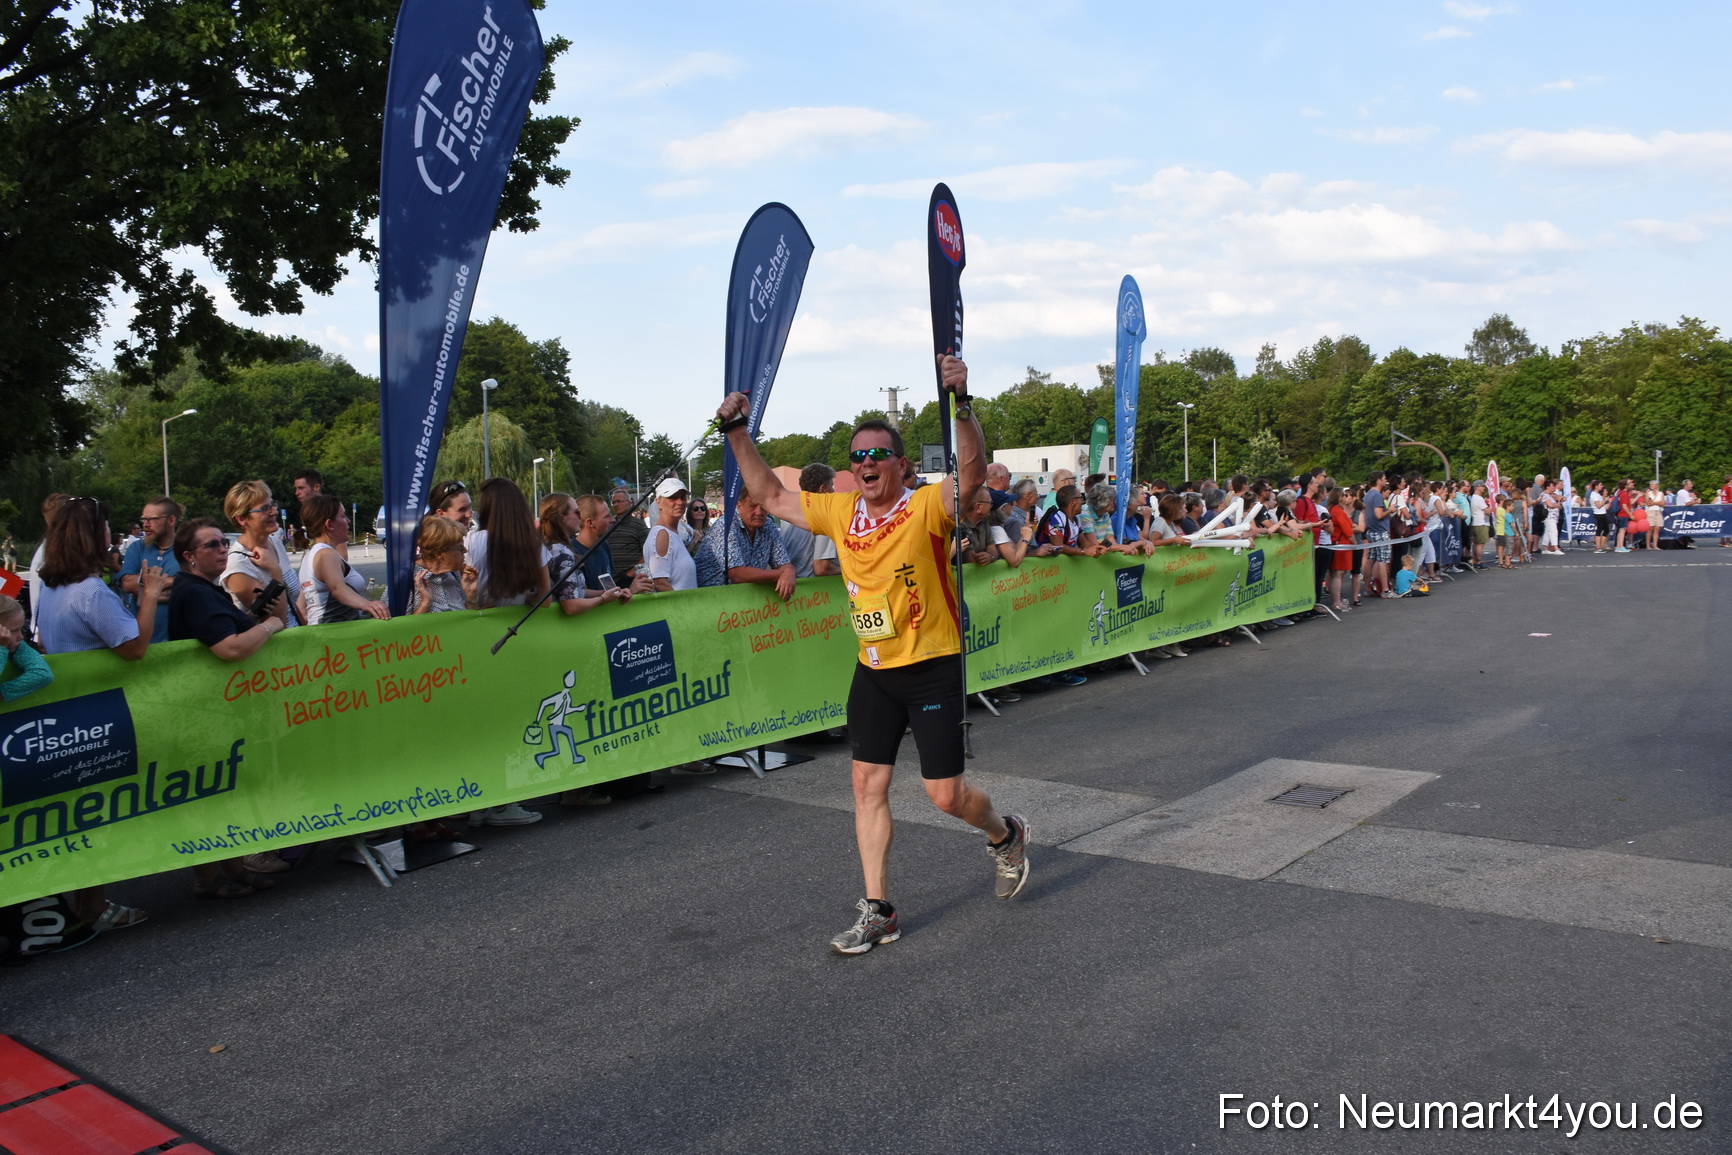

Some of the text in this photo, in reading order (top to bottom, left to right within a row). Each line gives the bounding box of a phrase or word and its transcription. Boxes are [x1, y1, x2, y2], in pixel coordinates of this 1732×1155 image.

[436, 6, 503, 166] Fischer
[468, 35, 515, 162] AUTOMOBILE
[757, 234, 787, 310] Fischer
[768, 248, 791, 309] AUTOMOBILE
[405, 264, 470, 511] www.fischer-automobile.de
[1672, 518, 1726, 529] Fischer
[1031, 564, 1060, 583] Firmen
[1237, 570, 1277, 606] firmenlauf
[1012, 578, 1070, 612] laufen länger!
[1107, 589, 1165, 631] firmenlauf
[749, 605, 849, 654] laufen länger!
[852, 612, 884, 629] 1588
[356, 634, 444, 670] Firmen
[620, 643, 664, 664] Fischer
[625, 654, 662, 669] AUTOMOBILE
[284, 653, 468, 728] laufen länger!
[585, 660, 731, 740] firmenlauf
[24, 722, 114, 756] Fischer
[36, 738, 110, 764] AUTOMOBILE
[593, 722, 661, 756] neumarkt
[171, 777, 483, 855] www.firmenlauf-oberpfalz.de
